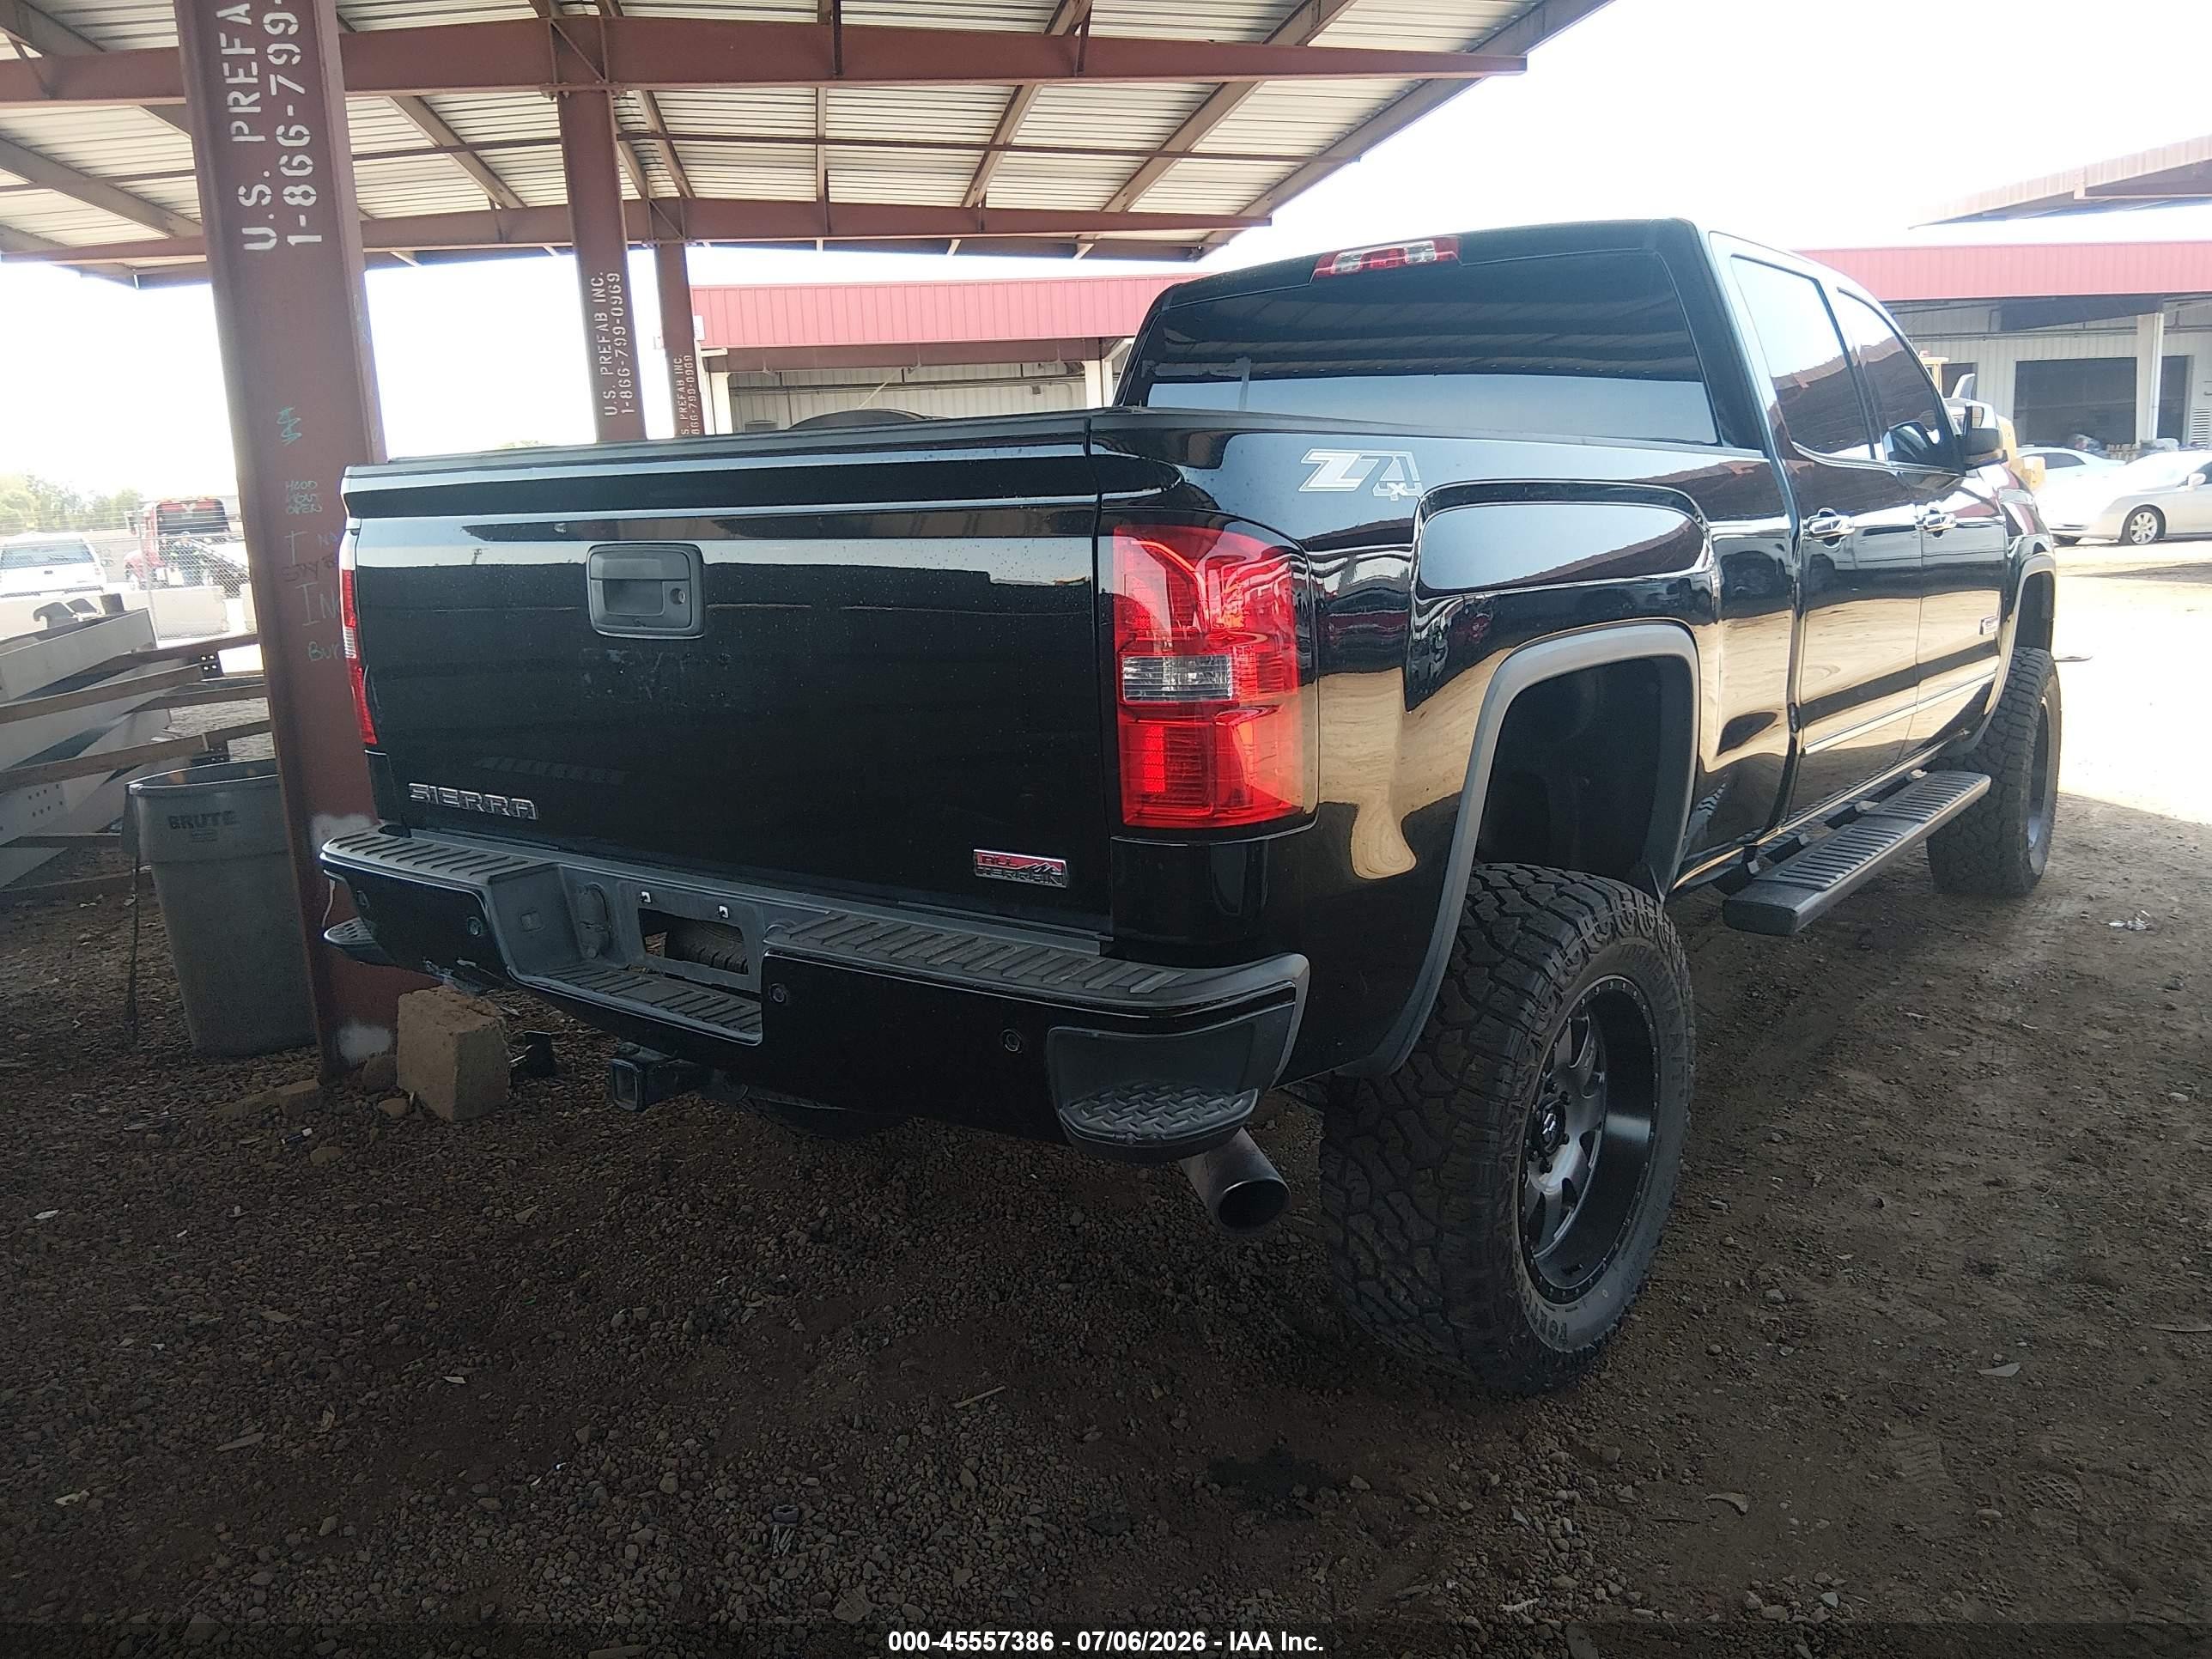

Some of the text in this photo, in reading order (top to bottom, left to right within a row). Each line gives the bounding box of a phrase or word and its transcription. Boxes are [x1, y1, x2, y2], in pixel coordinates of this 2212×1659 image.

[216, 3, 277, 250] U.S. PREFA
[590, 271, 619, 416] U.S. PREFAB INC.
[606, 272, 635, 415] 1-866-799-0969
[674, 379, 690, 421] PREFAB
[408, 782, 539, 820] SIERRA
